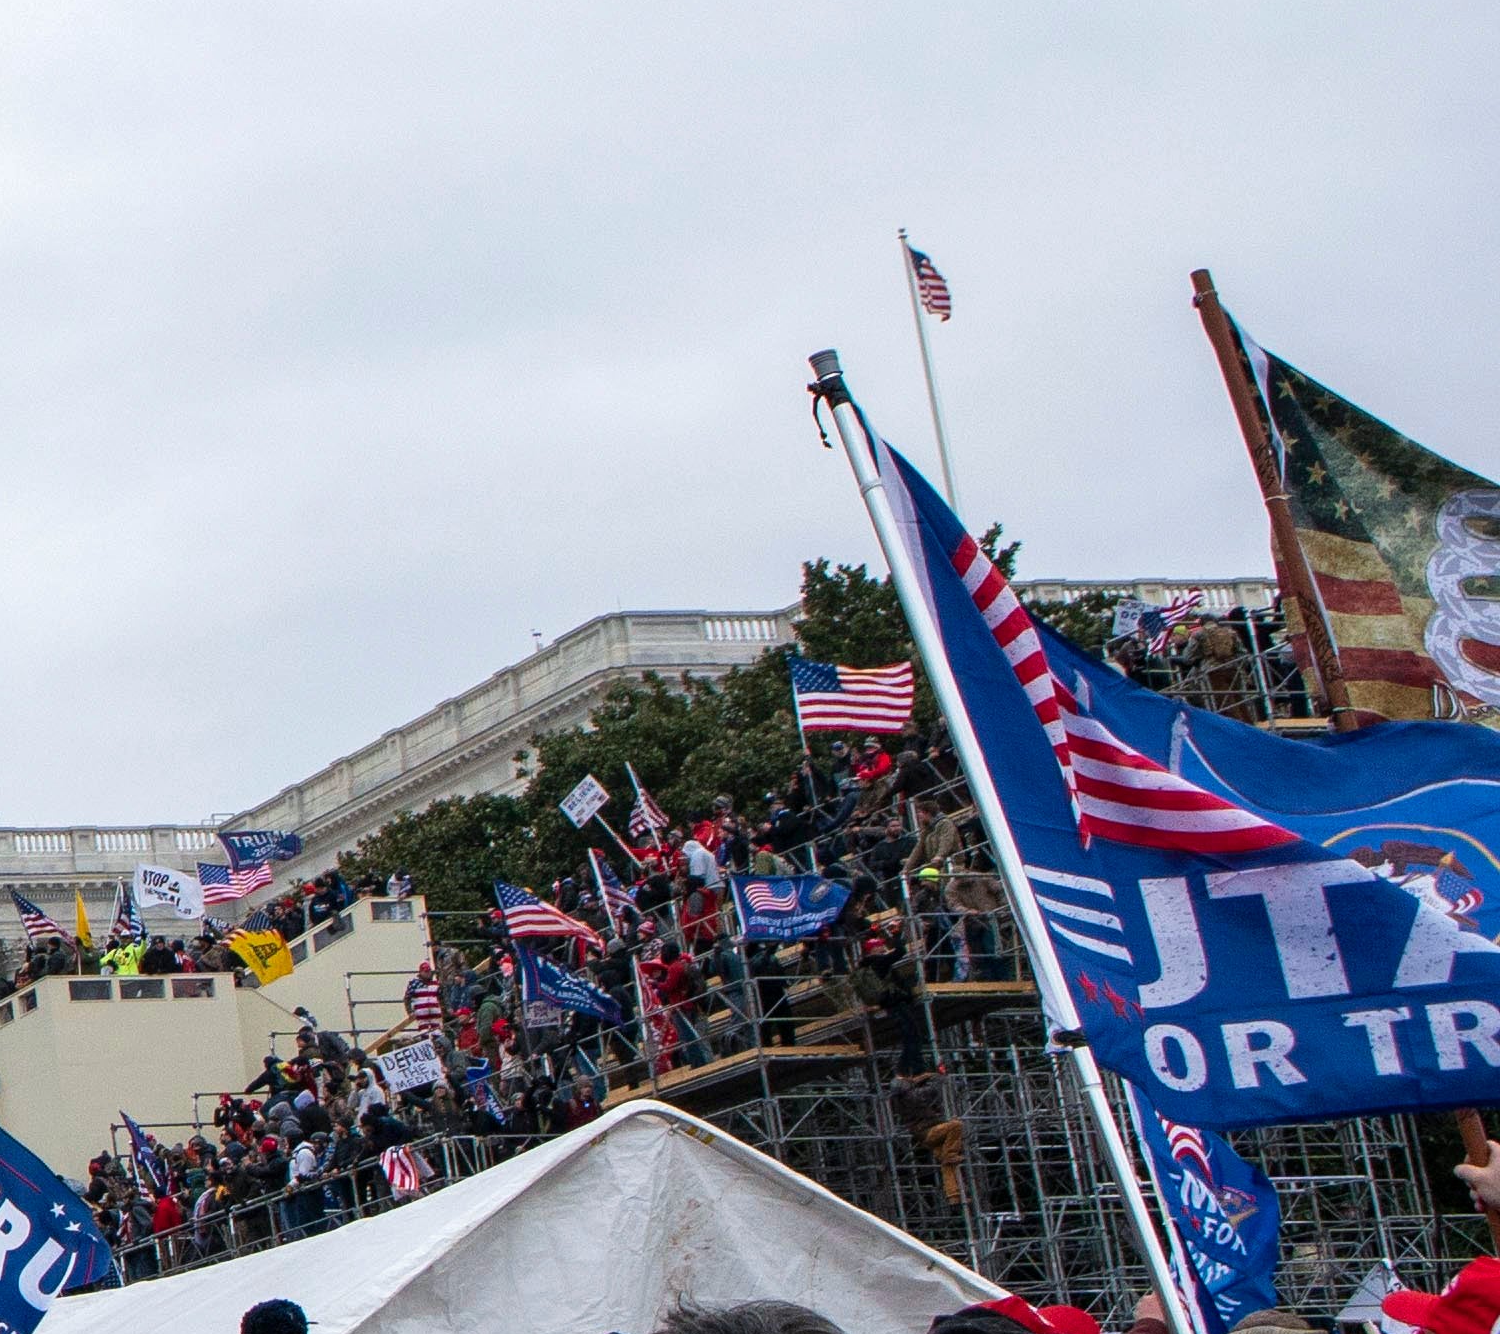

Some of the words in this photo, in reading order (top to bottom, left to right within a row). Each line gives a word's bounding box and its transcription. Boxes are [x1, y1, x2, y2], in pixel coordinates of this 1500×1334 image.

[142, 870, 170, 888] STOP
[399, 1063, 426, 1078] THE
[394, 1070, 439, 1091] MEDIA
